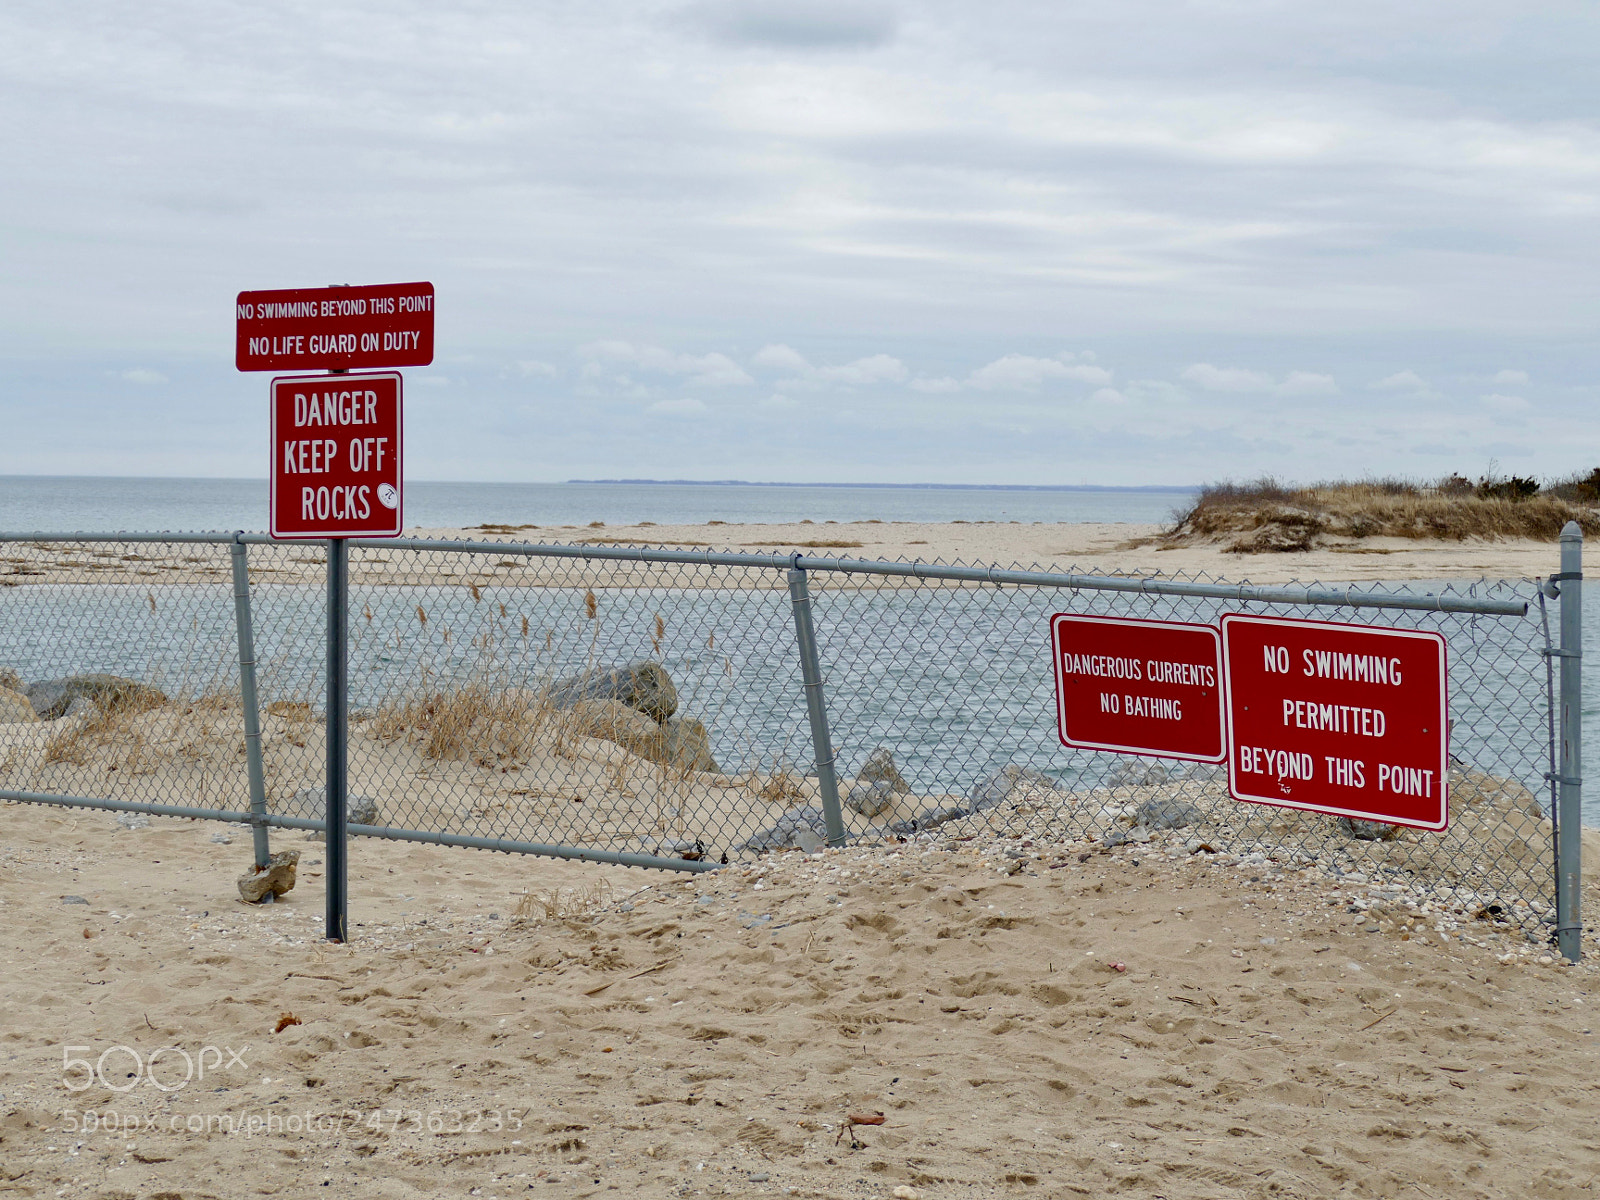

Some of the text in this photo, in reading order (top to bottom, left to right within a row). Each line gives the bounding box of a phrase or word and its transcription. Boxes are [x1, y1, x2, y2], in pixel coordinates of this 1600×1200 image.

[237, 295, 433, 320] NO SWIMMING BEYOND THIS POINT
[249, 331, 420, 356] NO LIFE GUARD ON DUTY
[294, 390, 378, 427] DANGER
[284, 437, 388, 474] KEEP OFF
[302, 484, 371, 521] ROCKS
[1064, 652, 1215, 688] DANGEROUS CURRENTS
[1263, 645, 1402, 686] NO SWIMMING
[1100, 692, 1182, 721] NO BATHING
[1283, 698, 1386, 738] PERMITTED
[1240, 745, 1434, 798] BEYOND THIS POINT
